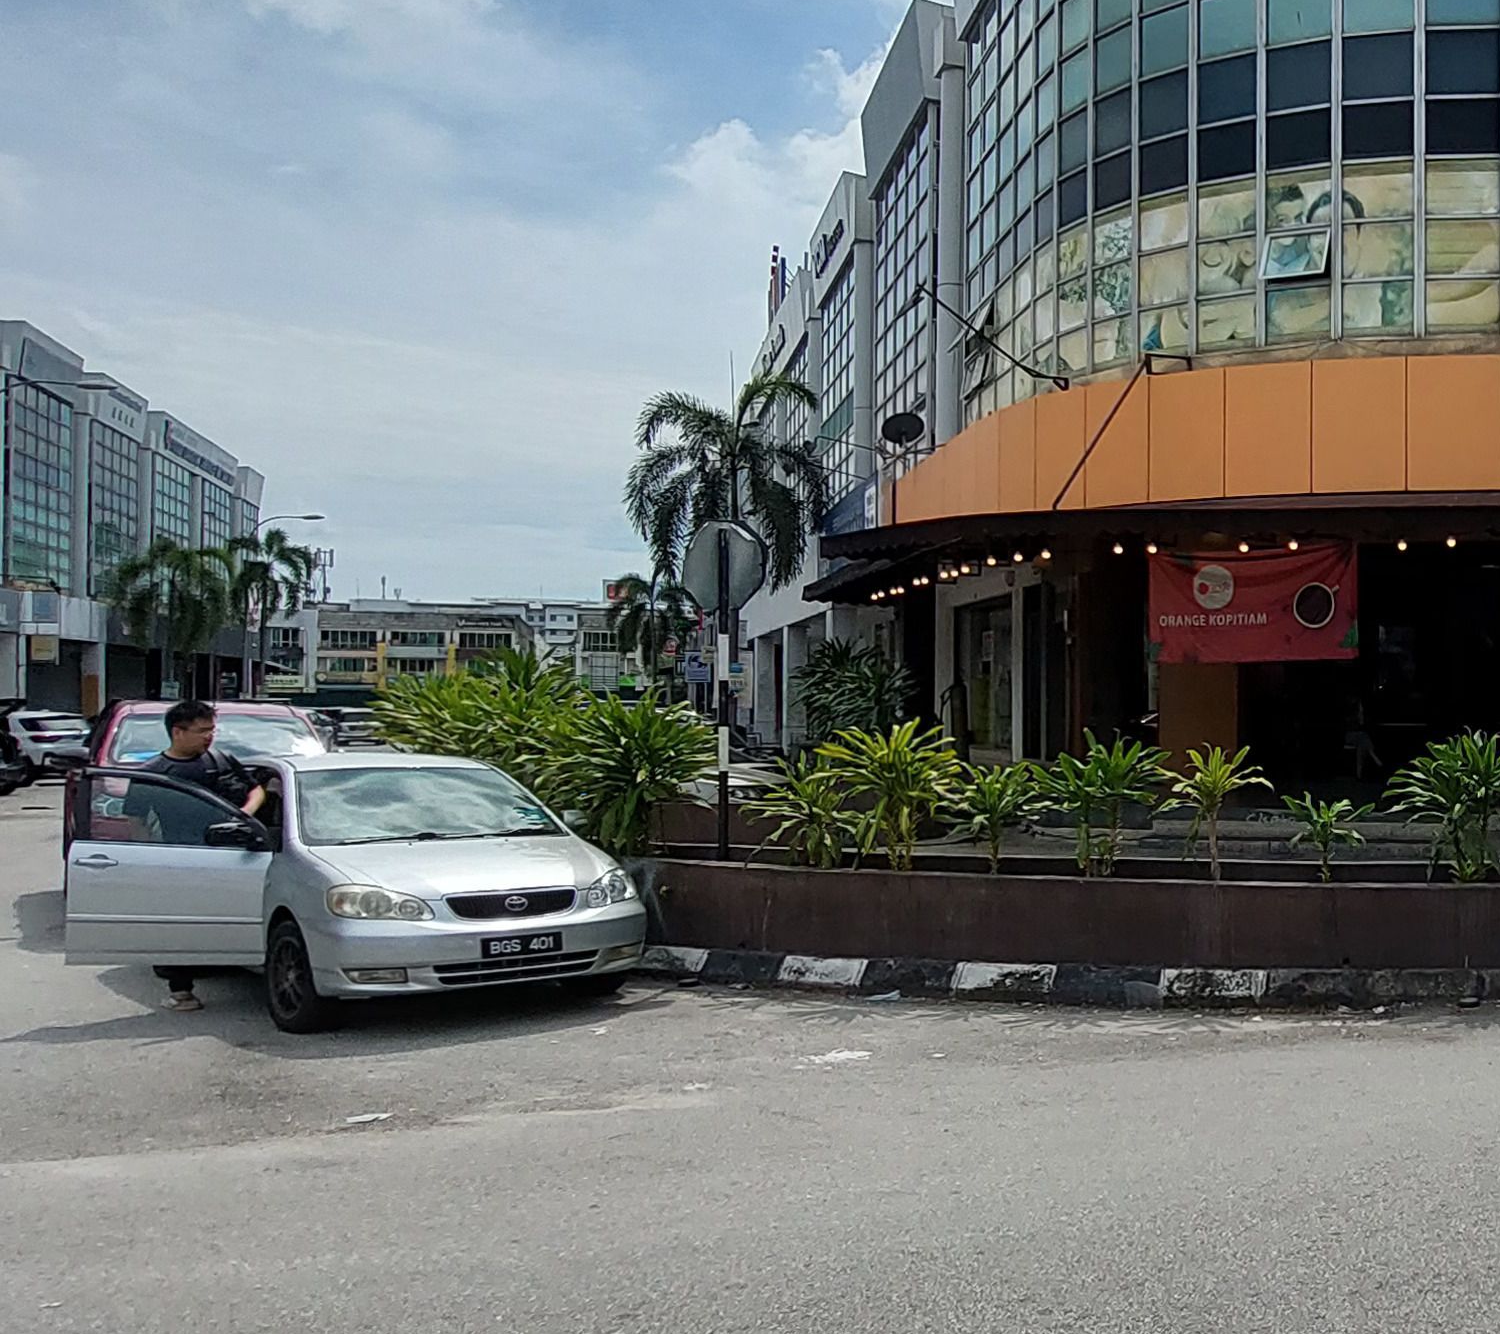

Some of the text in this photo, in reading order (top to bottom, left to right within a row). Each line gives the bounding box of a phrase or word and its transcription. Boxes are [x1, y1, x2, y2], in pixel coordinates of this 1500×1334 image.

[1159, 612, 1267, 628] ORANGE KOPITIAM
[489, 935, 554, 955] BGS 401
